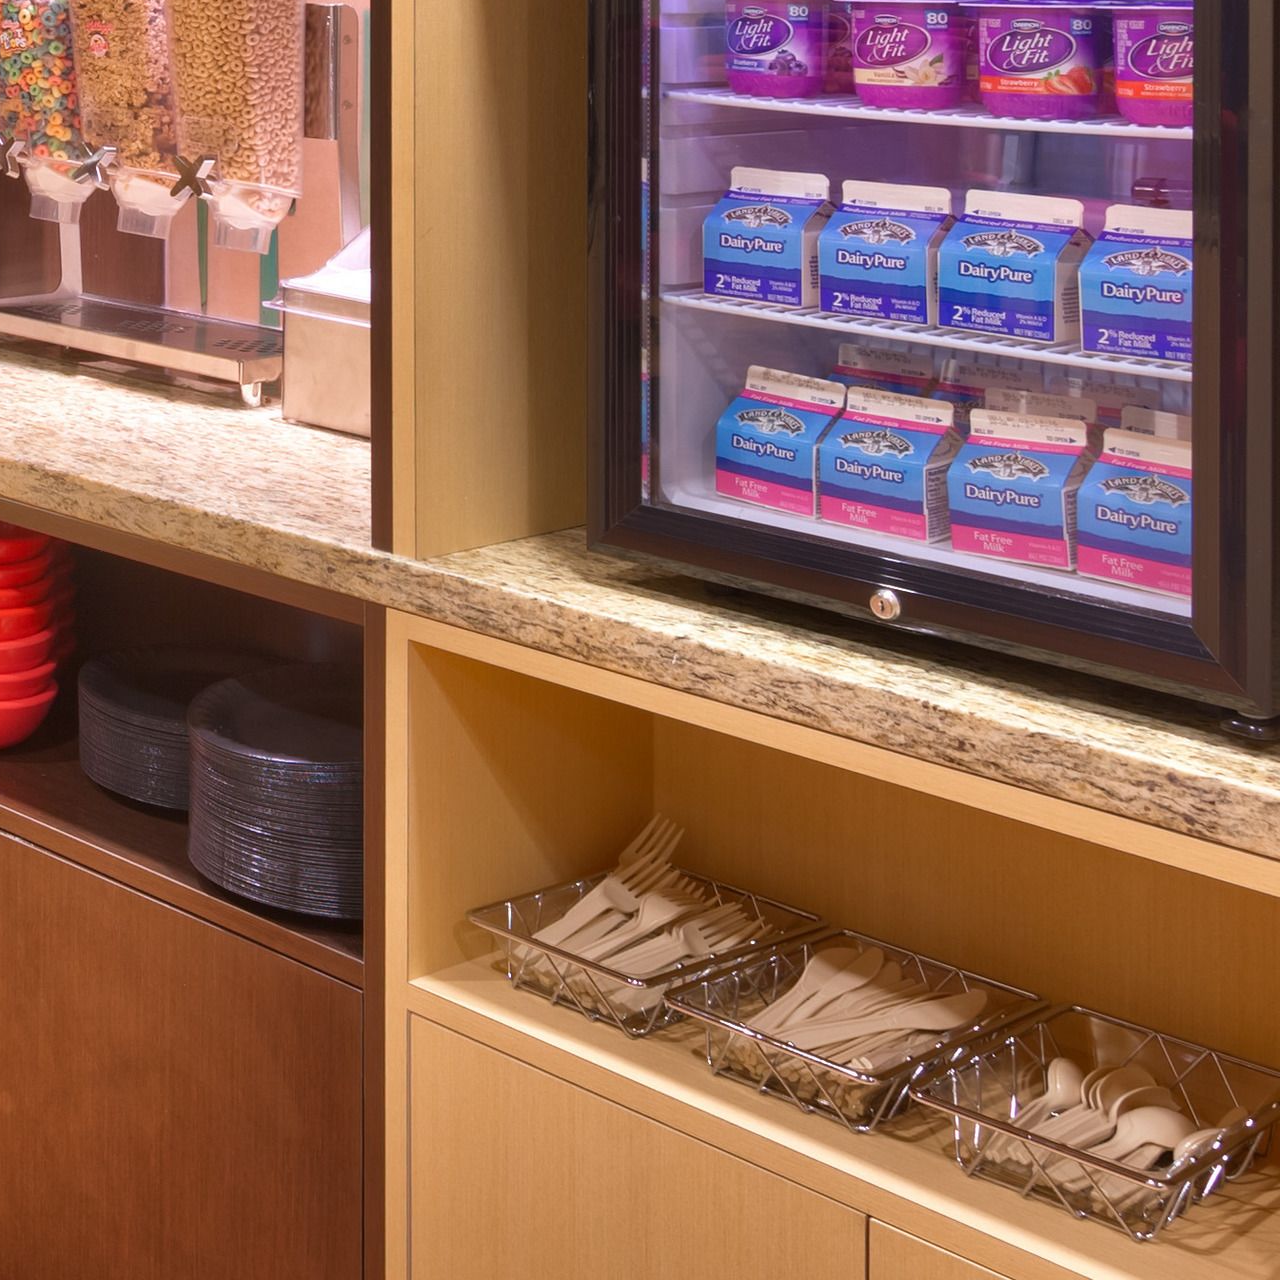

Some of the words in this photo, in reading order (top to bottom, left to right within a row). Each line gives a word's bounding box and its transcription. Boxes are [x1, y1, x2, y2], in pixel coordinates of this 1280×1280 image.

[789, 5, 809, 17] 80
[926, 12, 948, 25] 80
[736, 19, 774, 38] Light
[1071, 19, 1092, 31] 80
[866, 28, 910, 48] Light
[1002, 33, 1053, 54] Light
[1147, 35, 1193, 58] Ligh
[846, 221, 871, 233] LAND
[720, 234, 783, 253] DairyPure
[969, 233, 996, 245] LAND
[837, 249, 906, 269] DairyPure
[1111, 252, 1139, 265] LAND
[959, 261, 1033, 282] DairyPure
[715, 274, 731, 288] 2%
[731, 275, 761, 287] Reduced
[731, 282, 742, 290] Fat
[743, 283, 758, 292] Milk
[832, 291, 850, 307] 2%
[850, 294, 882, 305] Reduced
[1102, 282, 1182, 303] DairyPure
[850, 301, 862, 309] Fat
[862, 302, 879, 311] Milk
[952, 305, 970, 320] 2%
[971, 307, 1006, 320] Reduced
[971, 315, 984, 323] Fat
[984, 316, 1002, 326] Milk
[1097, 328, 1118, 345] 2%
[1118, 330, 1156, 342] Reduced
[1118, 339, 1132, 347] Fat
[1133, 339, 1153, 349] Milk
[847, 431, 872, 441] LAND
[733, 435, 795, 459] DairyPure
[975, 454, 1002, 465] LAND
[836, 458, 903, 482] DairyPure
[735, 477, 748, 488] Fat
[749, 480, 768, 493] Free
[1107, 477, 1137, 488] LAND
[742, 486, 761, 499] Milk
[965, 484, 1040, 507] DairyPure
[841, 502, 856, 514] Fat
[856, 505, 878, 519] Free
[849, 512, 869, 526] Milk
[1096, 505, 1177, 534] DairyPure
[973, 531, 989, 543] Fat
[990, 534, 1014, 547] Free
[983, 541, 1006, 553] Milk
[1101, 554, 1119, 566] Fat
[1119, 558, 1144, 572] Free
[1111, 565, 1136, 579] Milk
